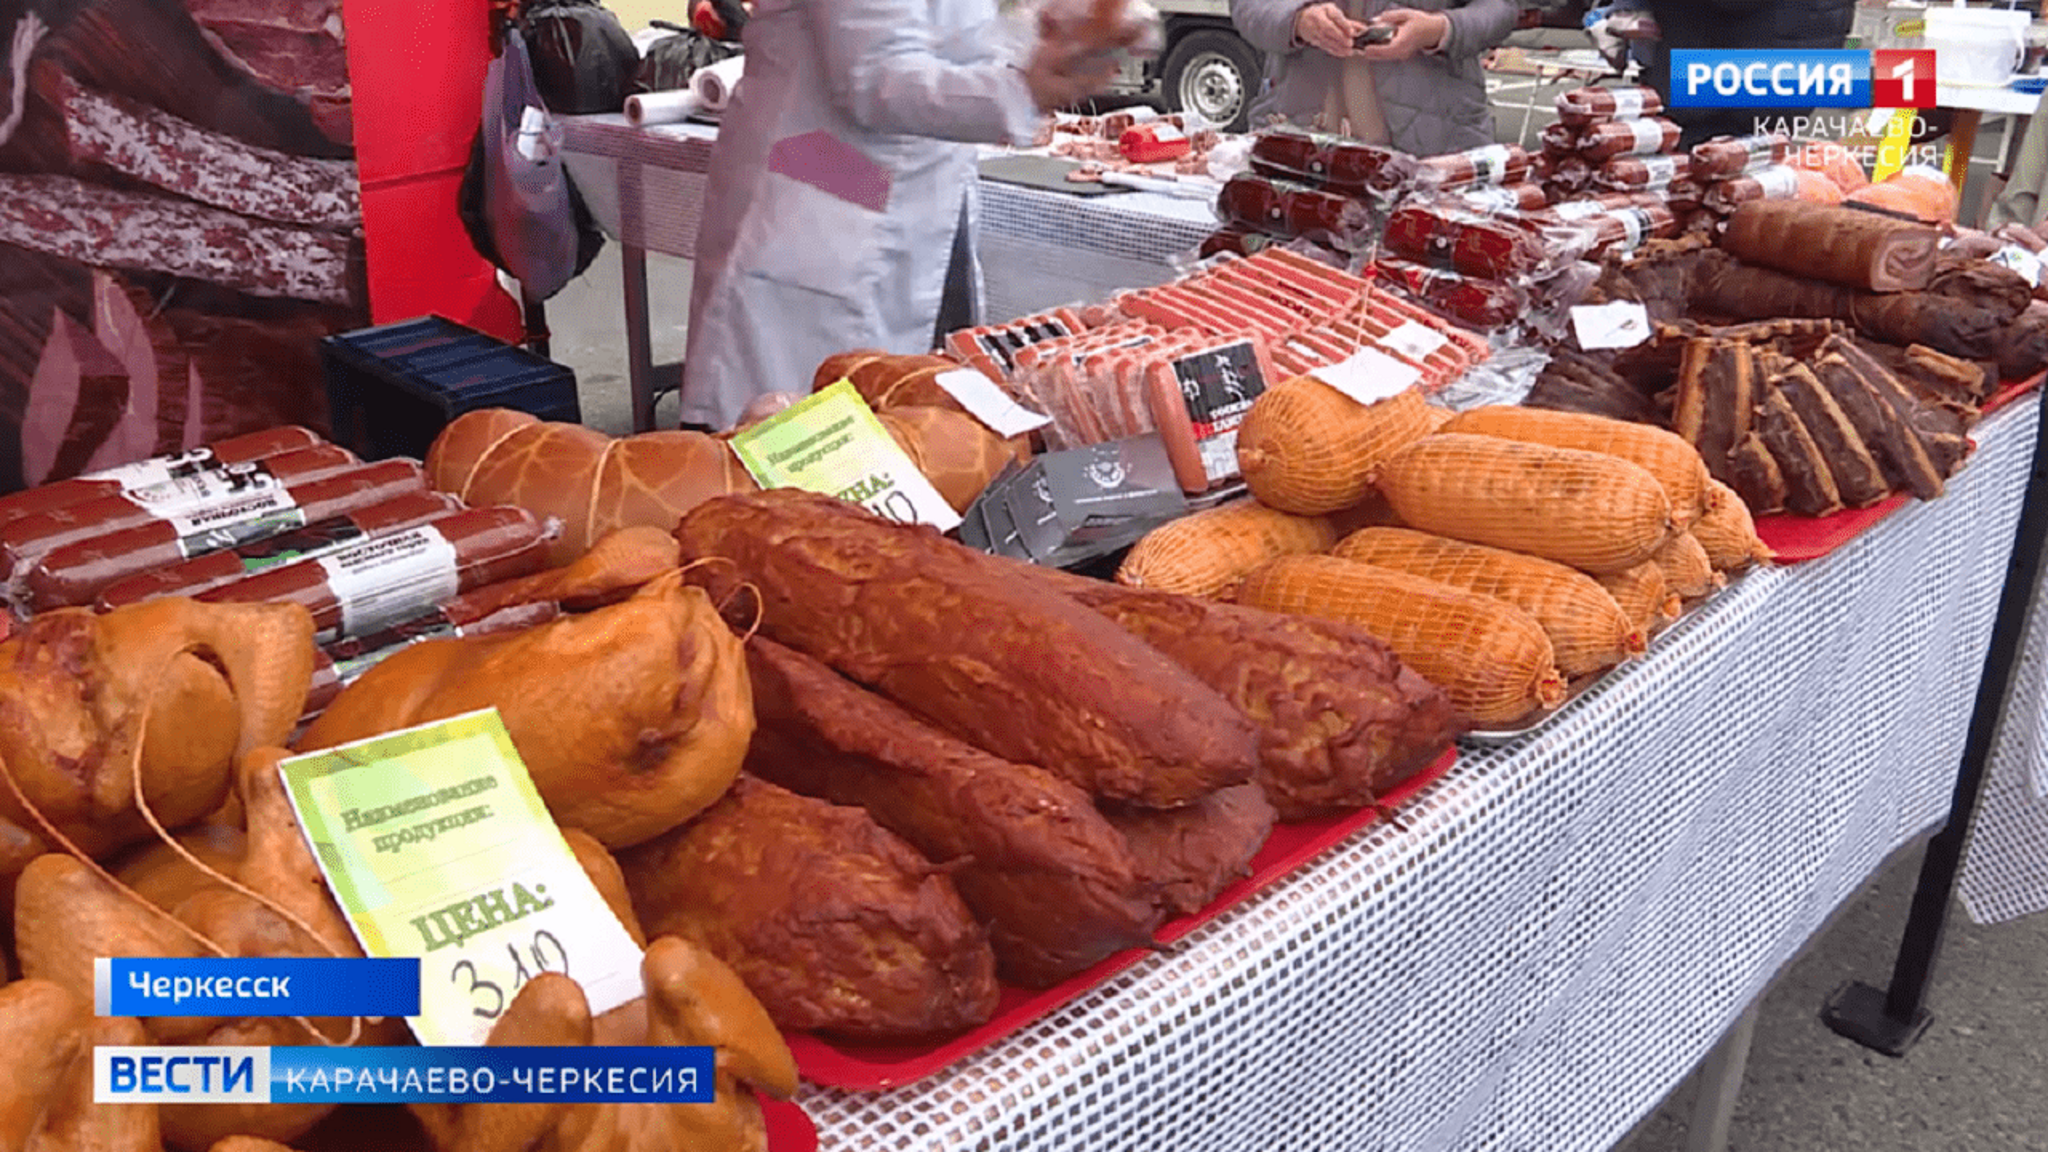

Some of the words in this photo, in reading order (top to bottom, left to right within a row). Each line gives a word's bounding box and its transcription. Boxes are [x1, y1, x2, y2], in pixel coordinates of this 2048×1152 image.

[339, 774, 499, 833] Наименование
[372, 803, 496, 854] продукции:
[409, 882, 555, 952] ЦЕНА:
[451, 929, 569, 1019] 310
